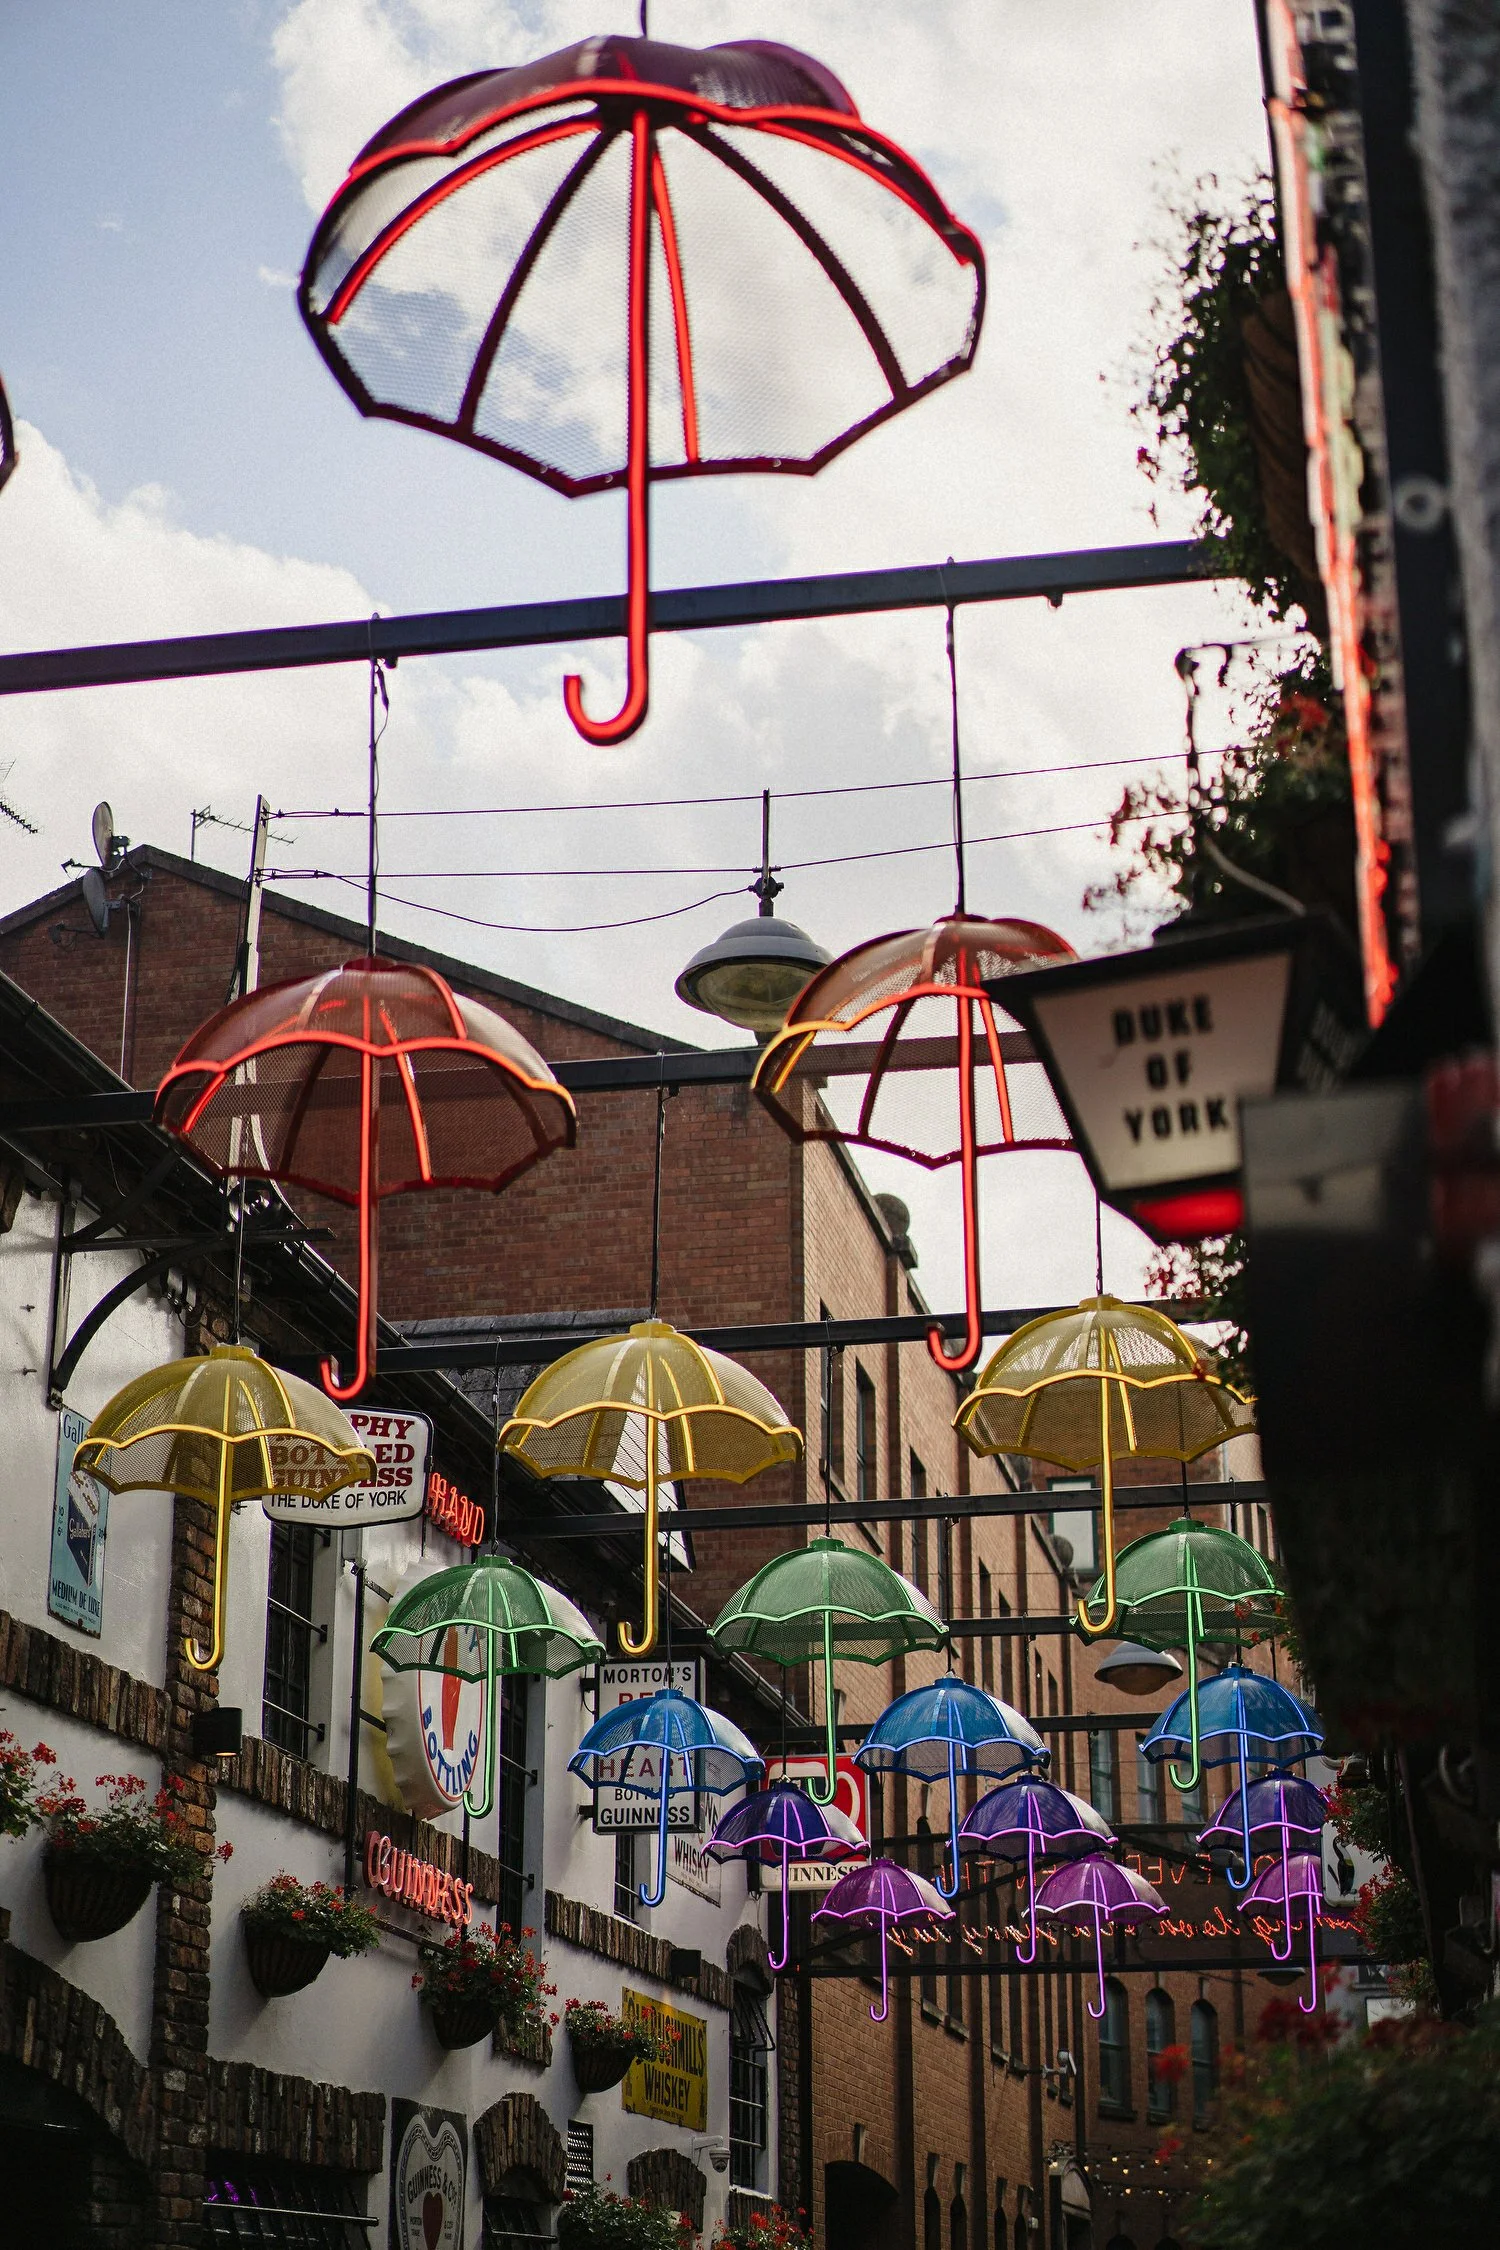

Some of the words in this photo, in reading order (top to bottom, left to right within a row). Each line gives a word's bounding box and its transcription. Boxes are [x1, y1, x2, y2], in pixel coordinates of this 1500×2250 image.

[1113, 995, 1212, 1046] DUKE
[1145, 1049, 1192, 1092] OF
[1125, 1099, 1230, 1145] YORK
[271, 1494, 297, 1508] THE
[301, 1493, 340, 1510] DUKE
[345, 1492, 365, 1510] OF
[369, 1489, 407, 1508] YORK
[600, 1805, 690, 1825] GUINNSS
[674, 1835, 710, 1884] WHISKY
[643, 2063, 691, 2113] WHISKEY
